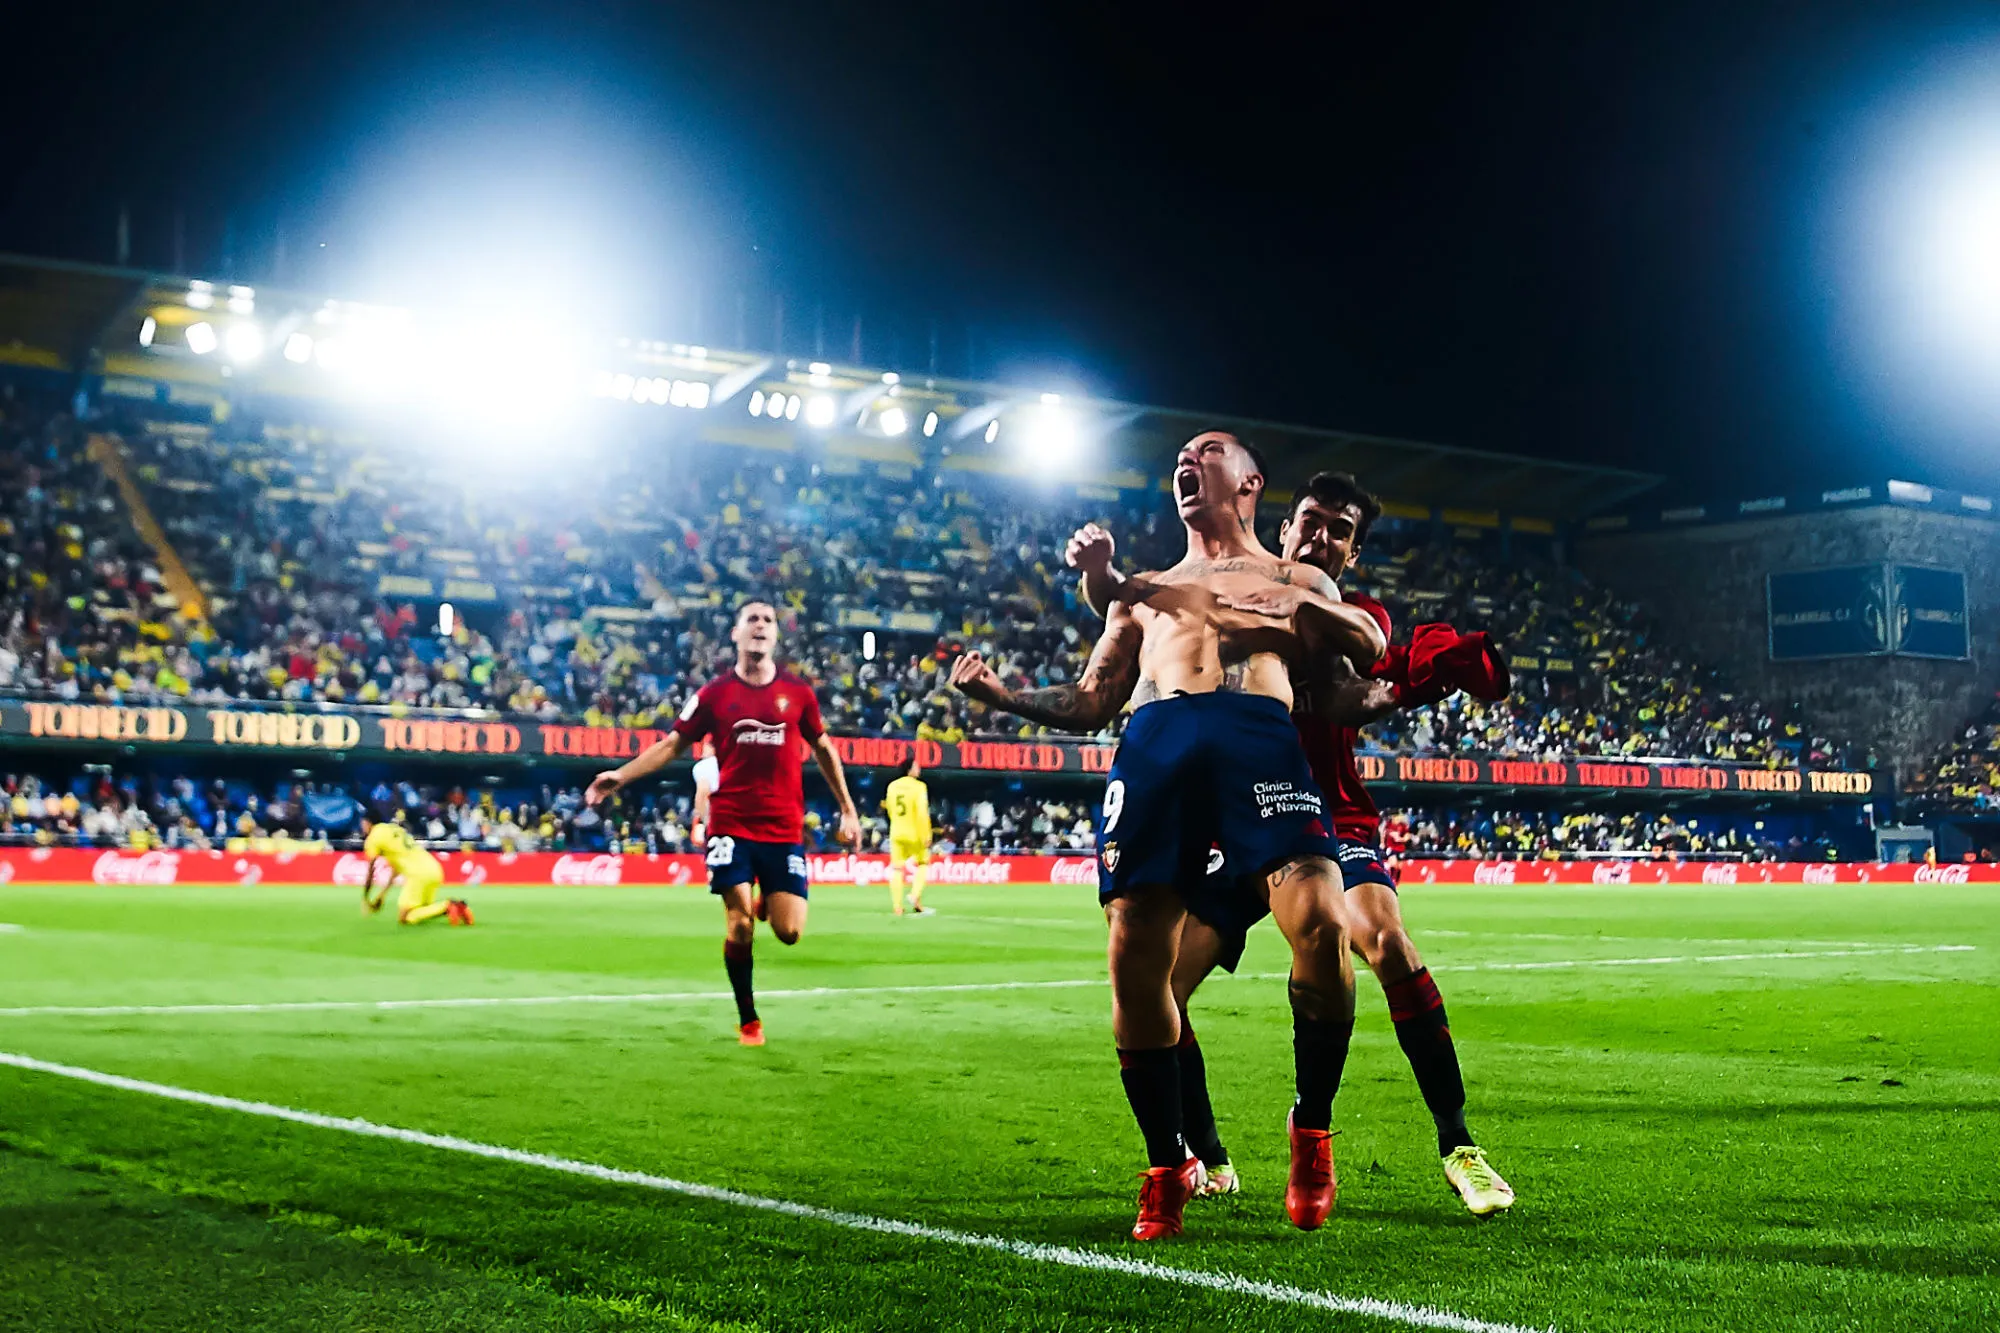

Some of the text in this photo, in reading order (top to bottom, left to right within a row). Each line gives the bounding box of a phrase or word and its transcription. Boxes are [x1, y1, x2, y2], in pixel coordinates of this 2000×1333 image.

[896, 795, 906, 817] 5
[1103, 780, 1125, 834] 9
[1256, 790, 1322, 806] Universidad
[1260, 802, 1321, 818] de Navarra
[904, 855, 1011, 883] Sntander
